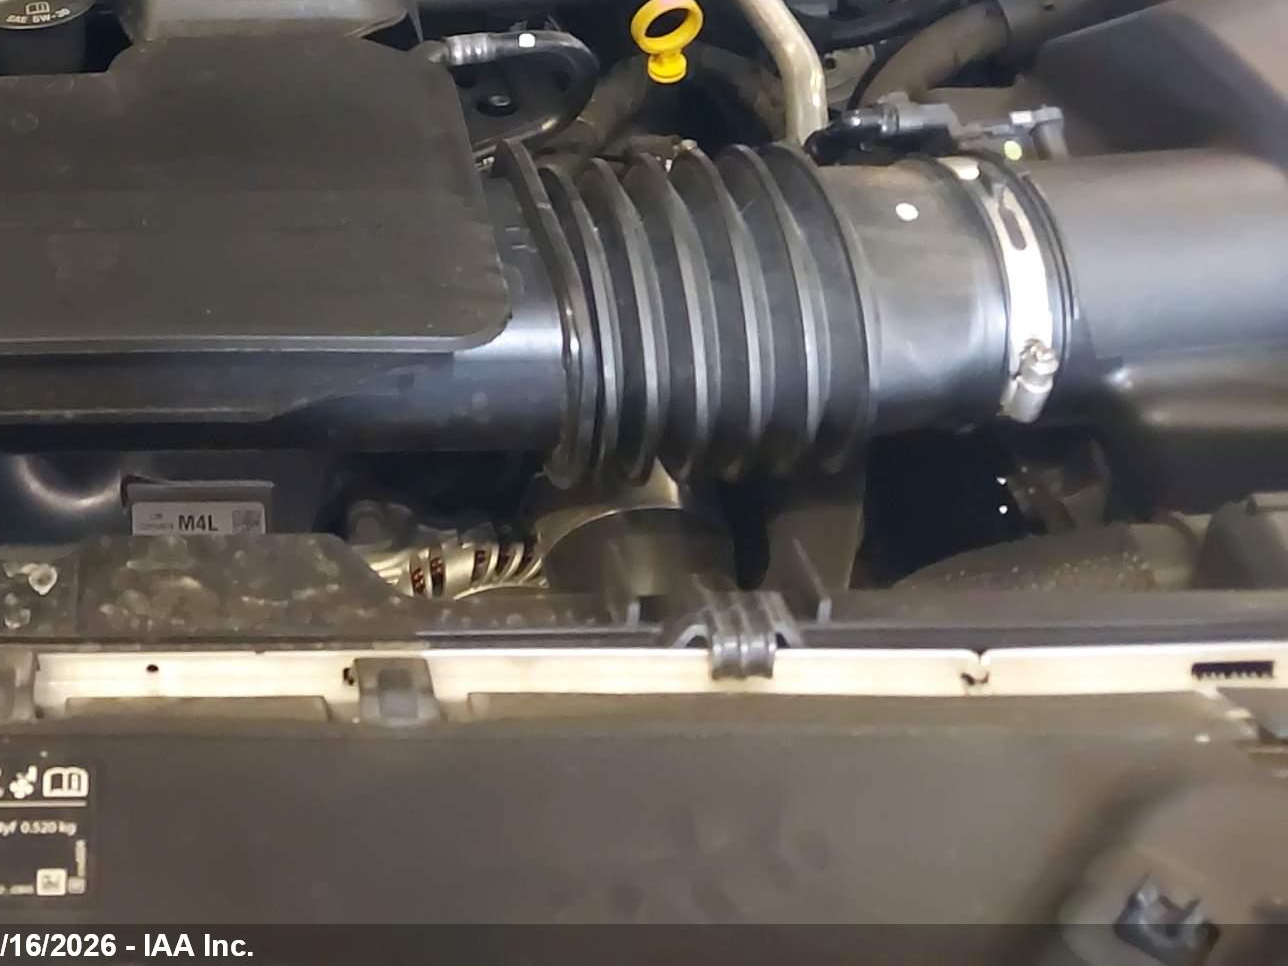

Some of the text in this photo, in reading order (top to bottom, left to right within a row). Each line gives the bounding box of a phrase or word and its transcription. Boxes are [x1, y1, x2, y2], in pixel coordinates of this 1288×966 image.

[178, 514, 219, 531] M4L
[20, 821, 57, 834] 0.520
[59, 820, 77, 836] kg
